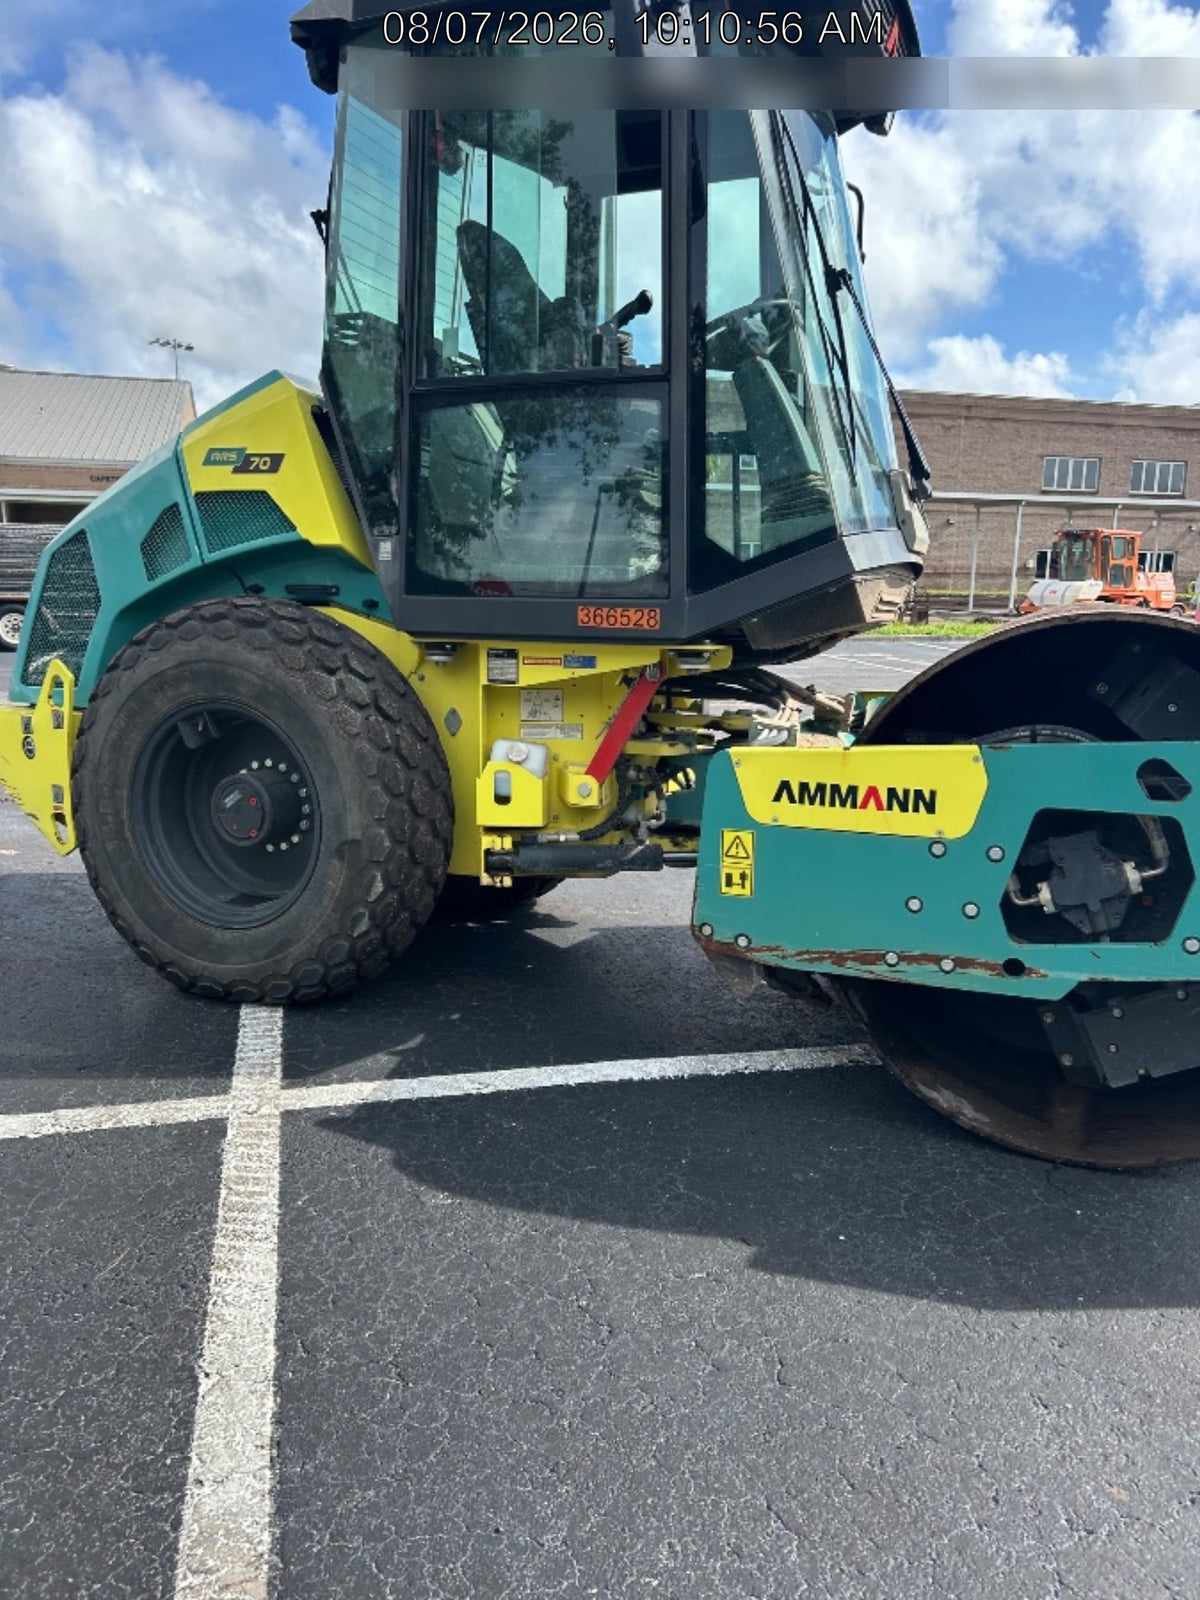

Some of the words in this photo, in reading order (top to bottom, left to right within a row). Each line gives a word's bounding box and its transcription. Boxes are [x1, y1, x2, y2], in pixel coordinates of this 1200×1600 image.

[249, 456, 271, 470] 70
[579, 607, 659, 629] 366528
[772, 780, 937, 815] AMMANN
